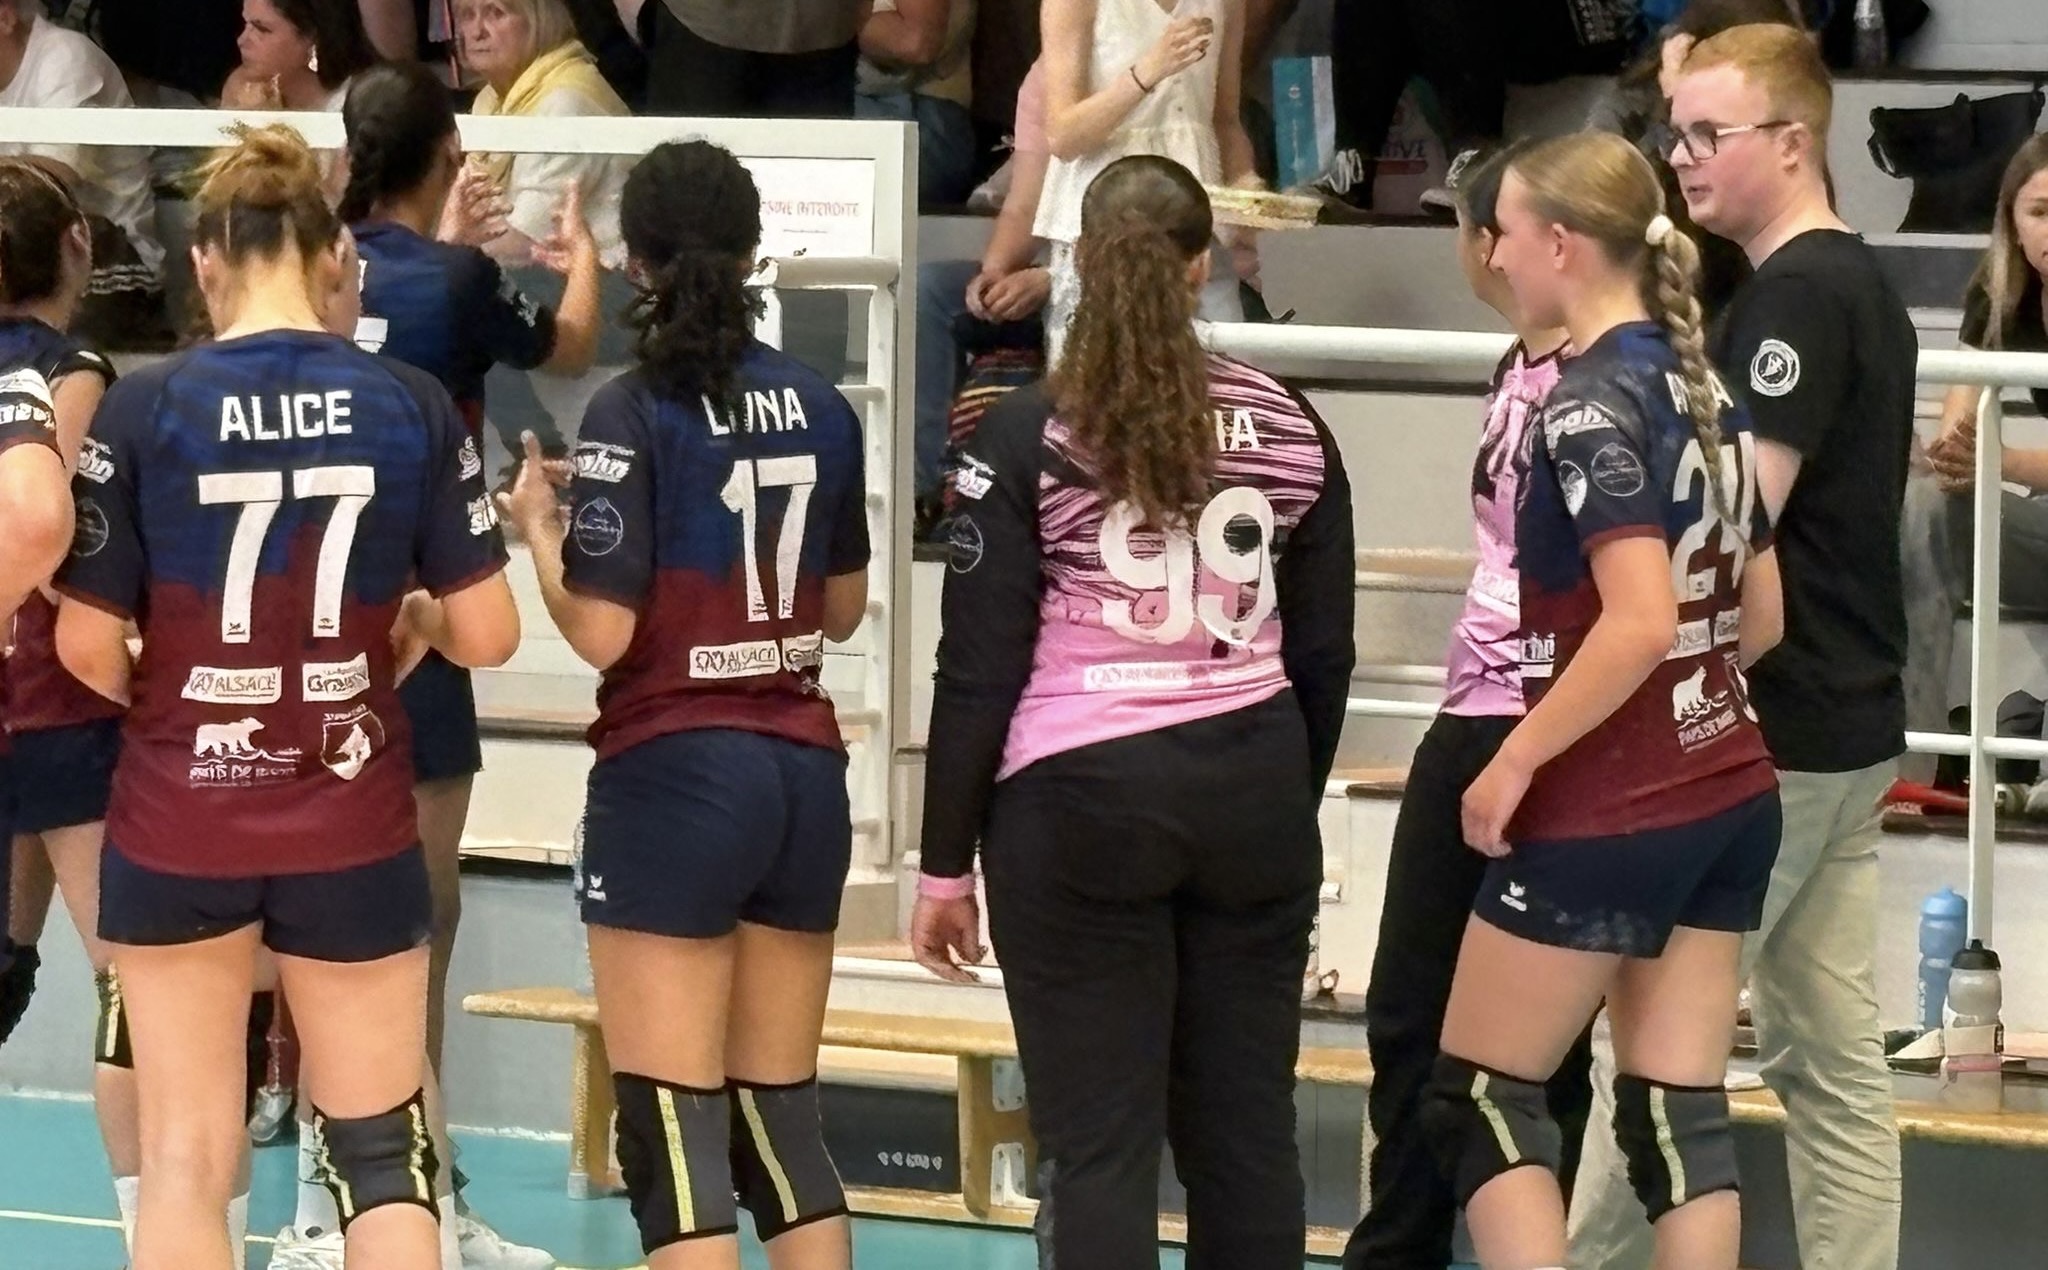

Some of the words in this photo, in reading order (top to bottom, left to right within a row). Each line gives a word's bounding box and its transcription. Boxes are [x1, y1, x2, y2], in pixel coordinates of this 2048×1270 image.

[219, 390, 353, 441] ALICE
[198, 465, 375, 643] 77
[719, 454, 817, 622] 17
[1099, 486, 1277, 646] 99
